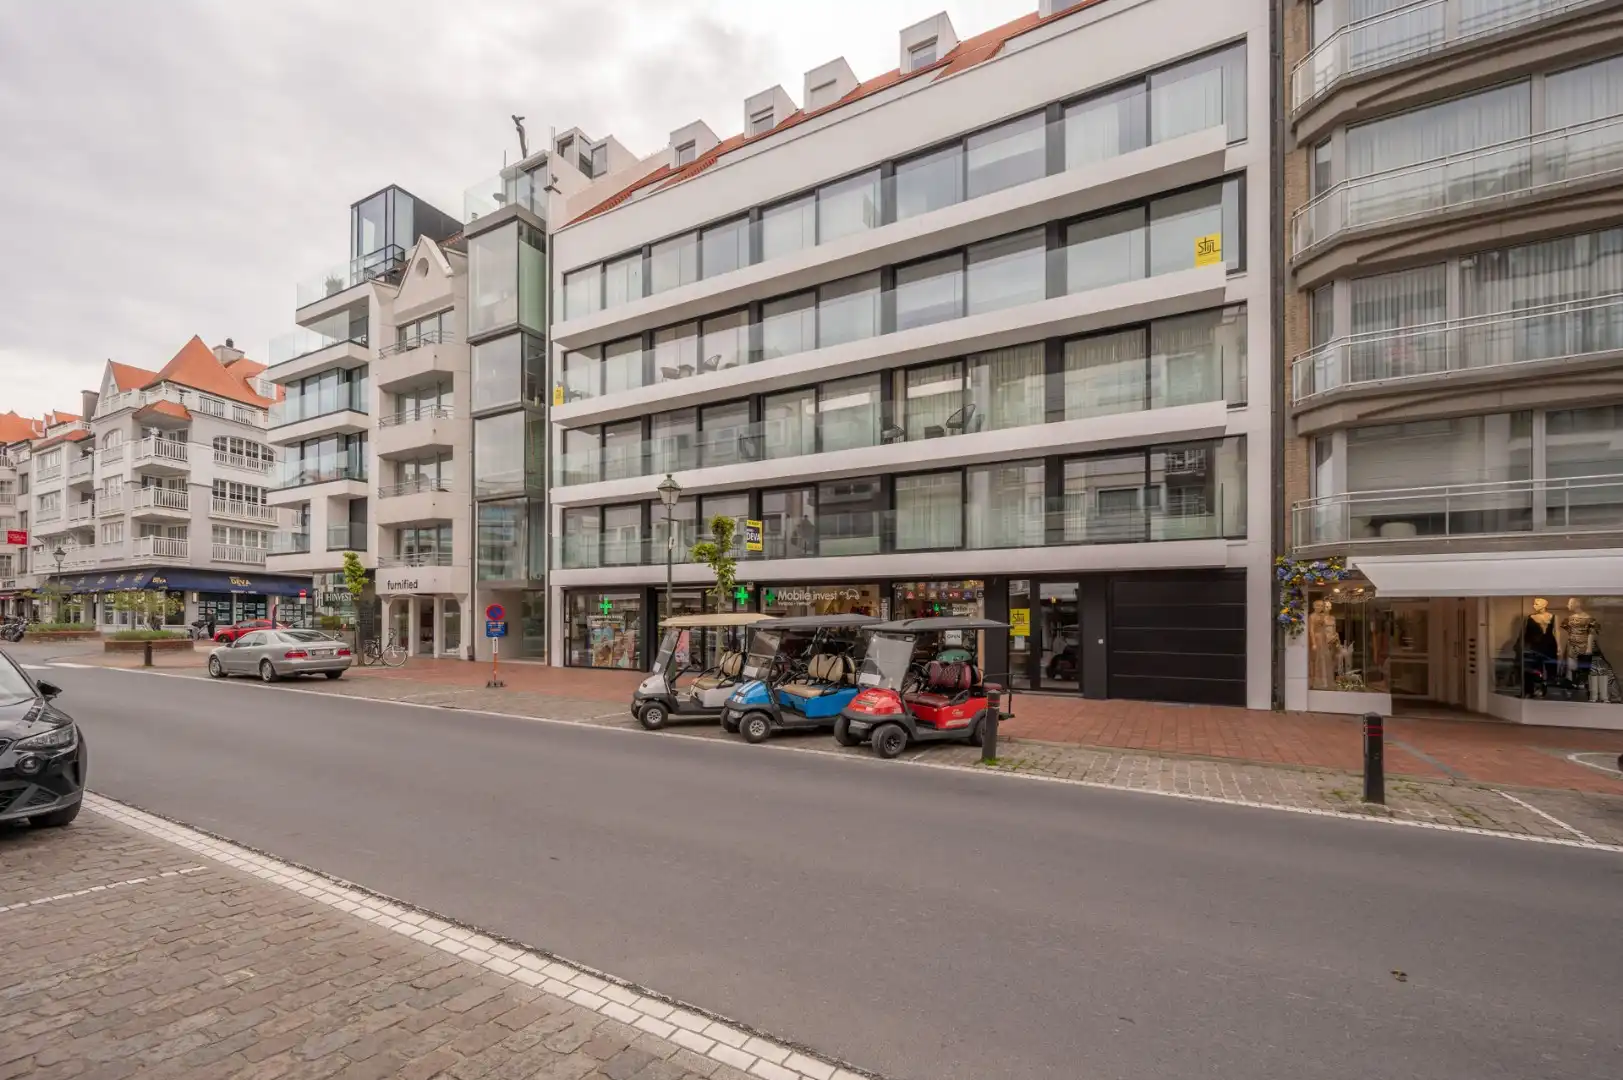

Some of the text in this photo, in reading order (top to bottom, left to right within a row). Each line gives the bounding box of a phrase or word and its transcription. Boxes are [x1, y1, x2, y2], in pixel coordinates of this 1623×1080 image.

[746, 532, 760, 542] DEVA
[387, 578, 418, 590] furnified
[777, 589, 838, 601] Mobile invest
